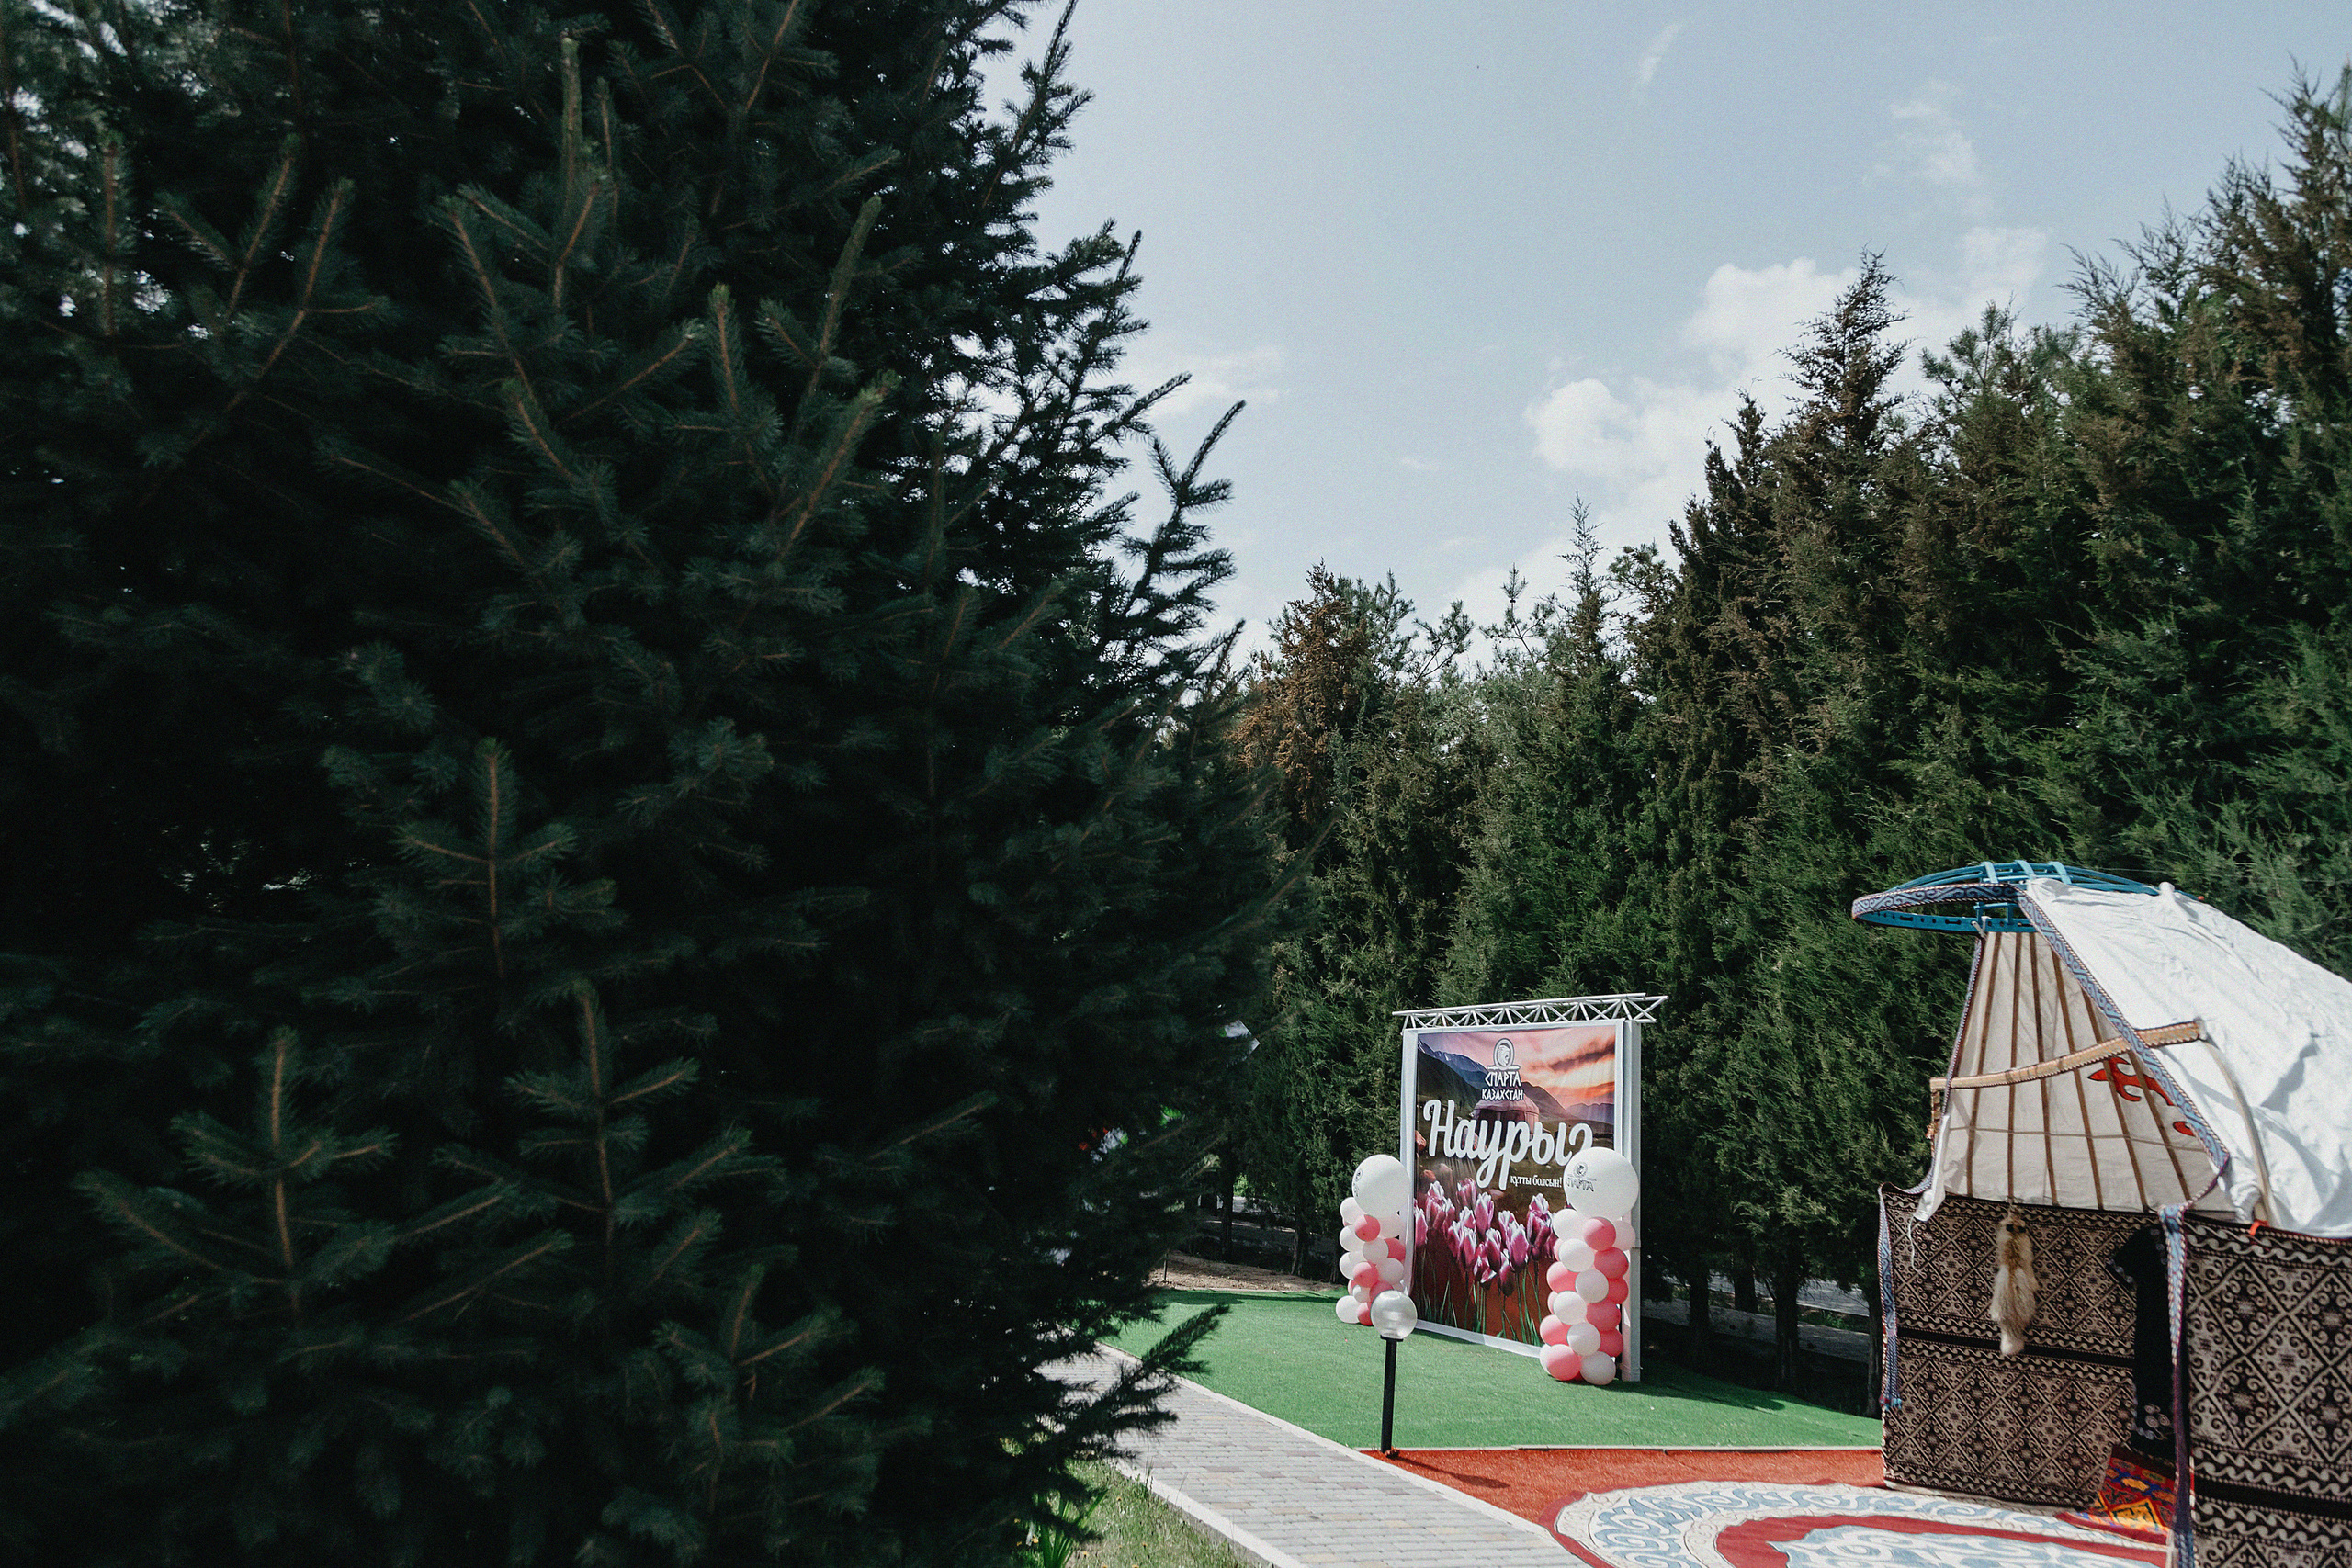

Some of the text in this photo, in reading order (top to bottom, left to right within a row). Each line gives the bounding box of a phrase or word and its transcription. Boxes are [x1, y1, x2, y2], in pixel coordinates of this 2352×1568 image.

[1485, 1070, 1521, 1087] СПАРТА
[1481, 1088, 1524, 1100] КАЗАХСТАН
[1532, 1174, 1562, 1188] болсын!
